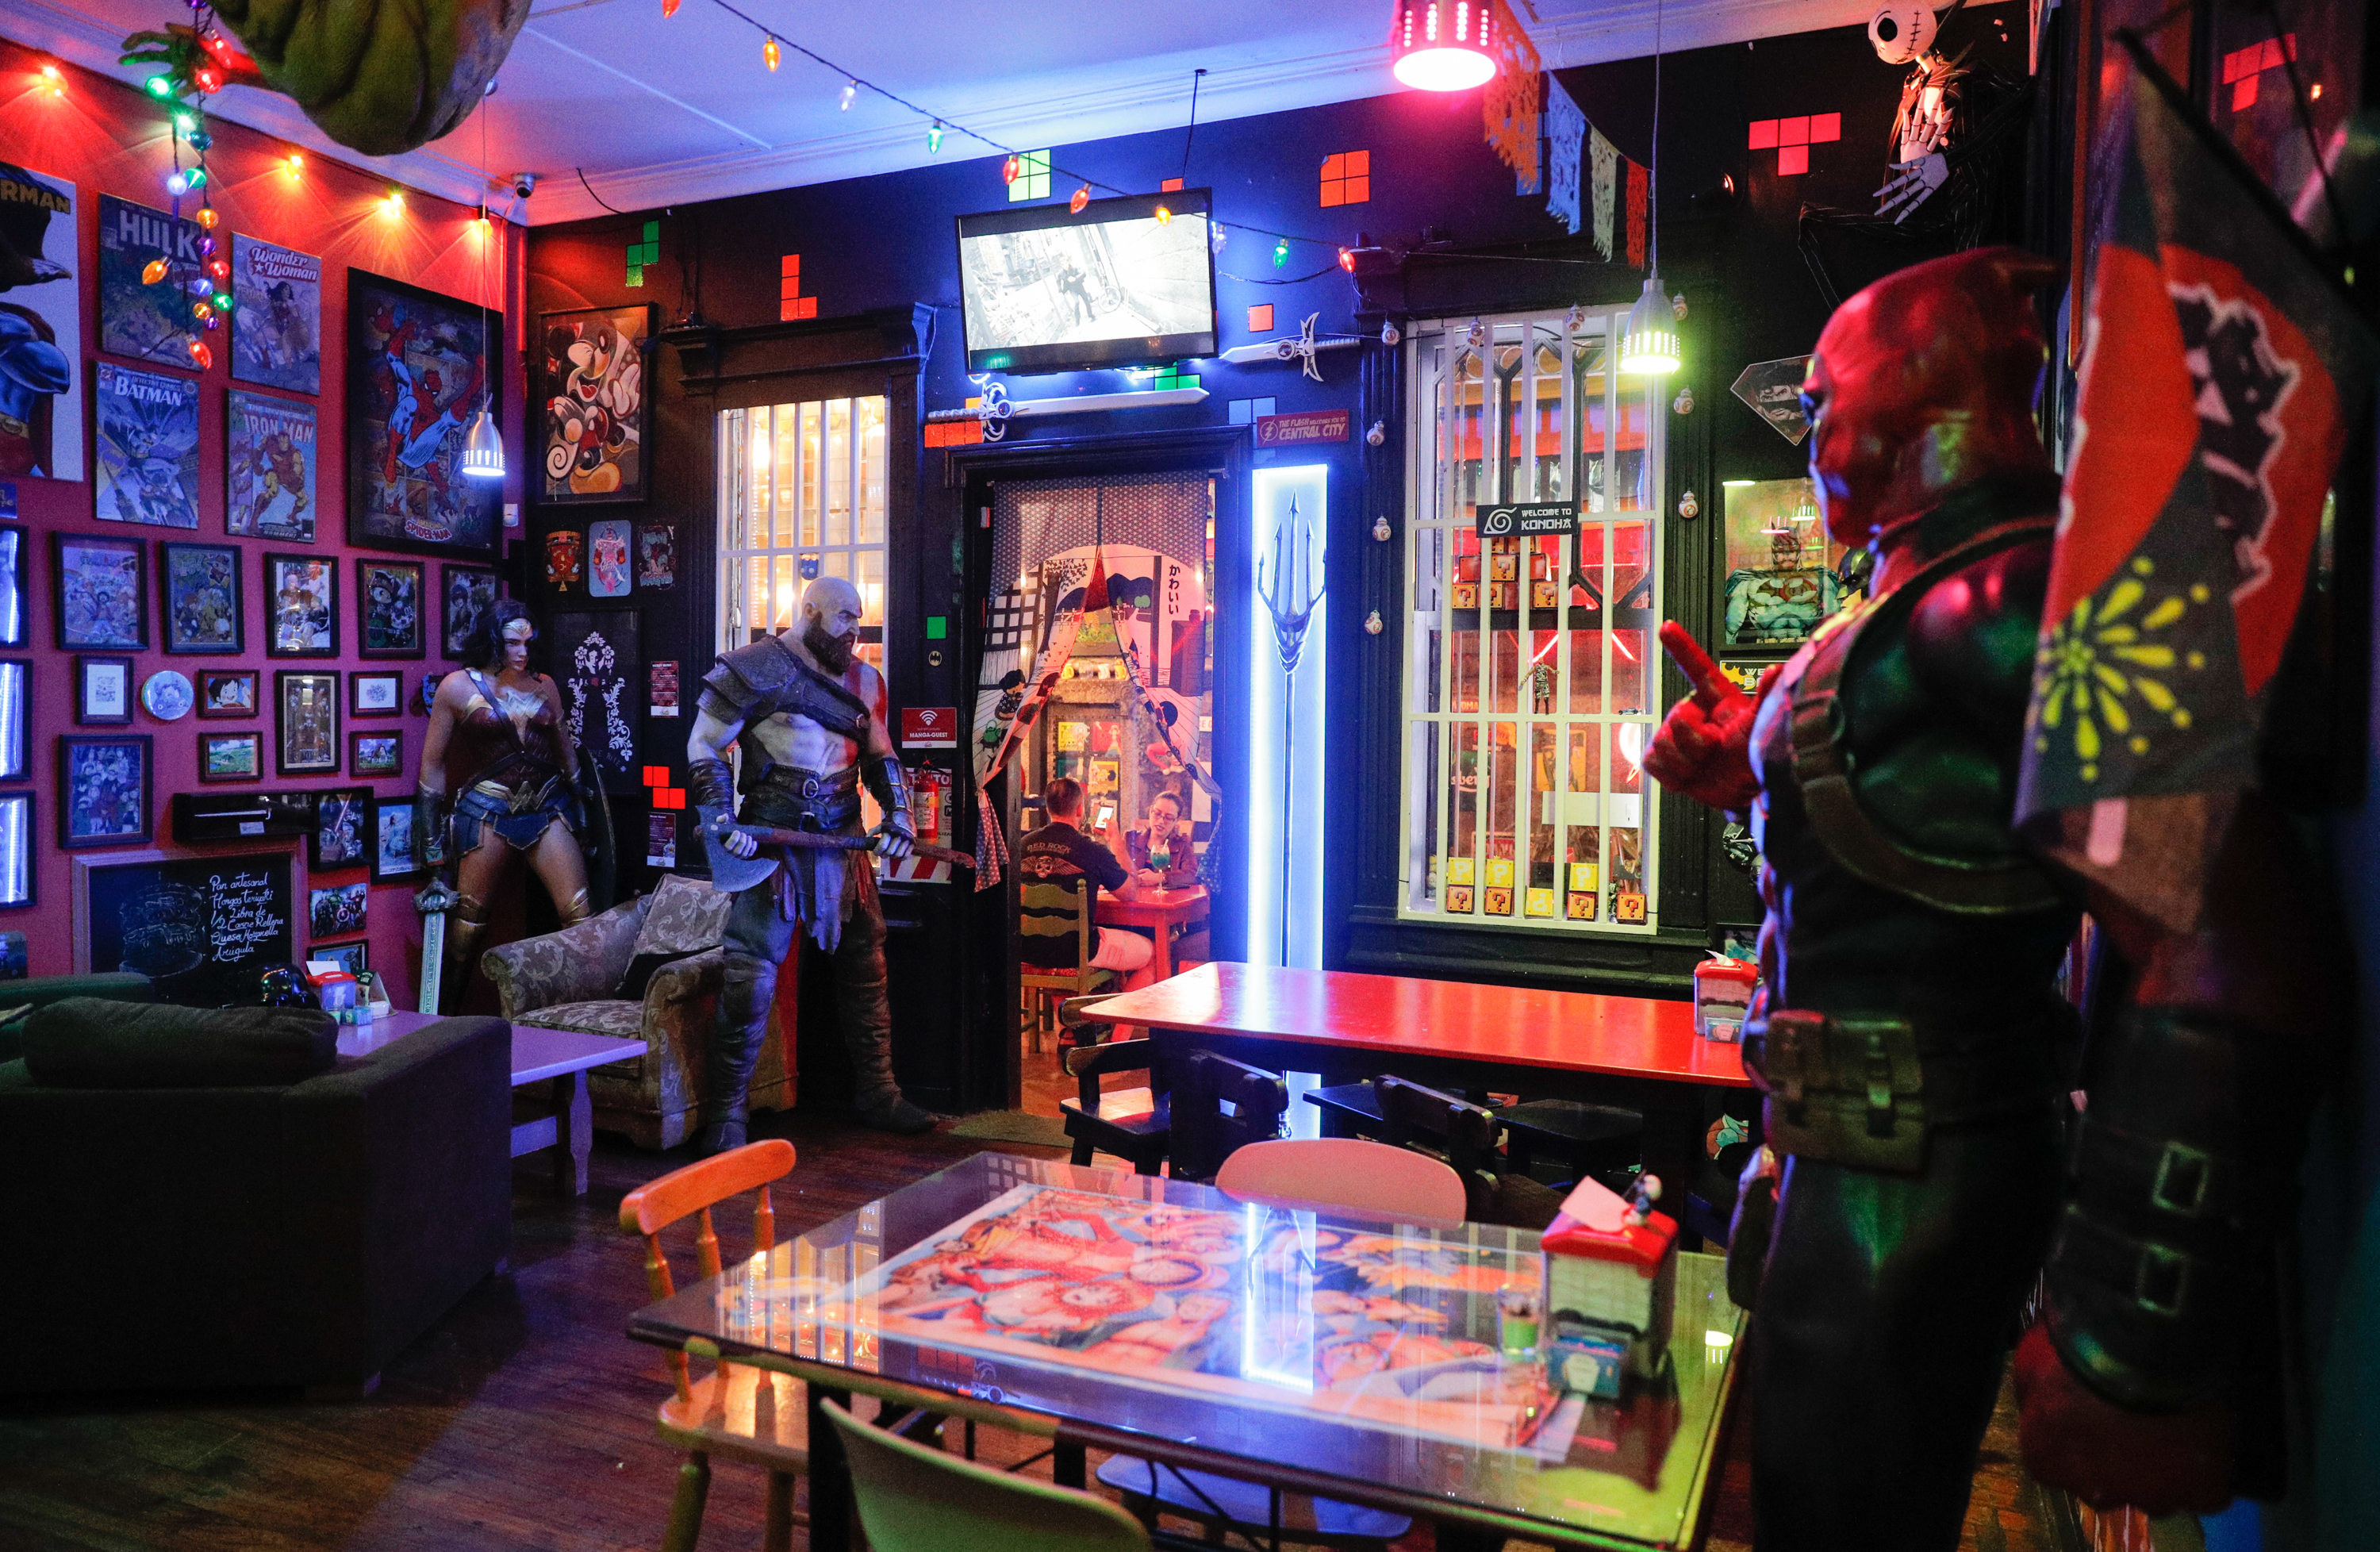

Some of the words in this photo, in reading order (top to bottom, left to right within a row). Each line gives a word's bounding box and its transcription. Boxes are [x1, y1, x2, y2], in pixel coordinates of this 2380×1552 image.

[120, 209, 200, 262] HULK
[251, 247, 309, 267] Wonder
[264, 262, 317, 281] Woman
[114, 375, 182, 406] BATMAN
[244, 411, 278, 436] IRON
[282, 417, 314, 444] MAN
[1279, 425, 1321, 440] CENTRAL
[1322, 423, 1346, 437] CITY
[1291, 418, 1310, 427] FLASH
[1522, 509, 1559, 517] WELCOME
[405, 520, 452, 541] SPIDER-MAN
[1521, 518, 1572, 531] KONOHA
[1168, 564, 1180, 615] かわいい
[1047, 843, 1072, 854] ROCK
[209, 874, 228, 892] Pan
[230, 871, 268, 889] artesanal
[209, 893, 242, 910] Hongos
[230, 906, 254, 918] Libra
[255, 905, 267, 916] de
[227, 919, 254, 932] Carne
[255, 913, 283, 928] Rellena
[210, 931, 242, 946] Queso
